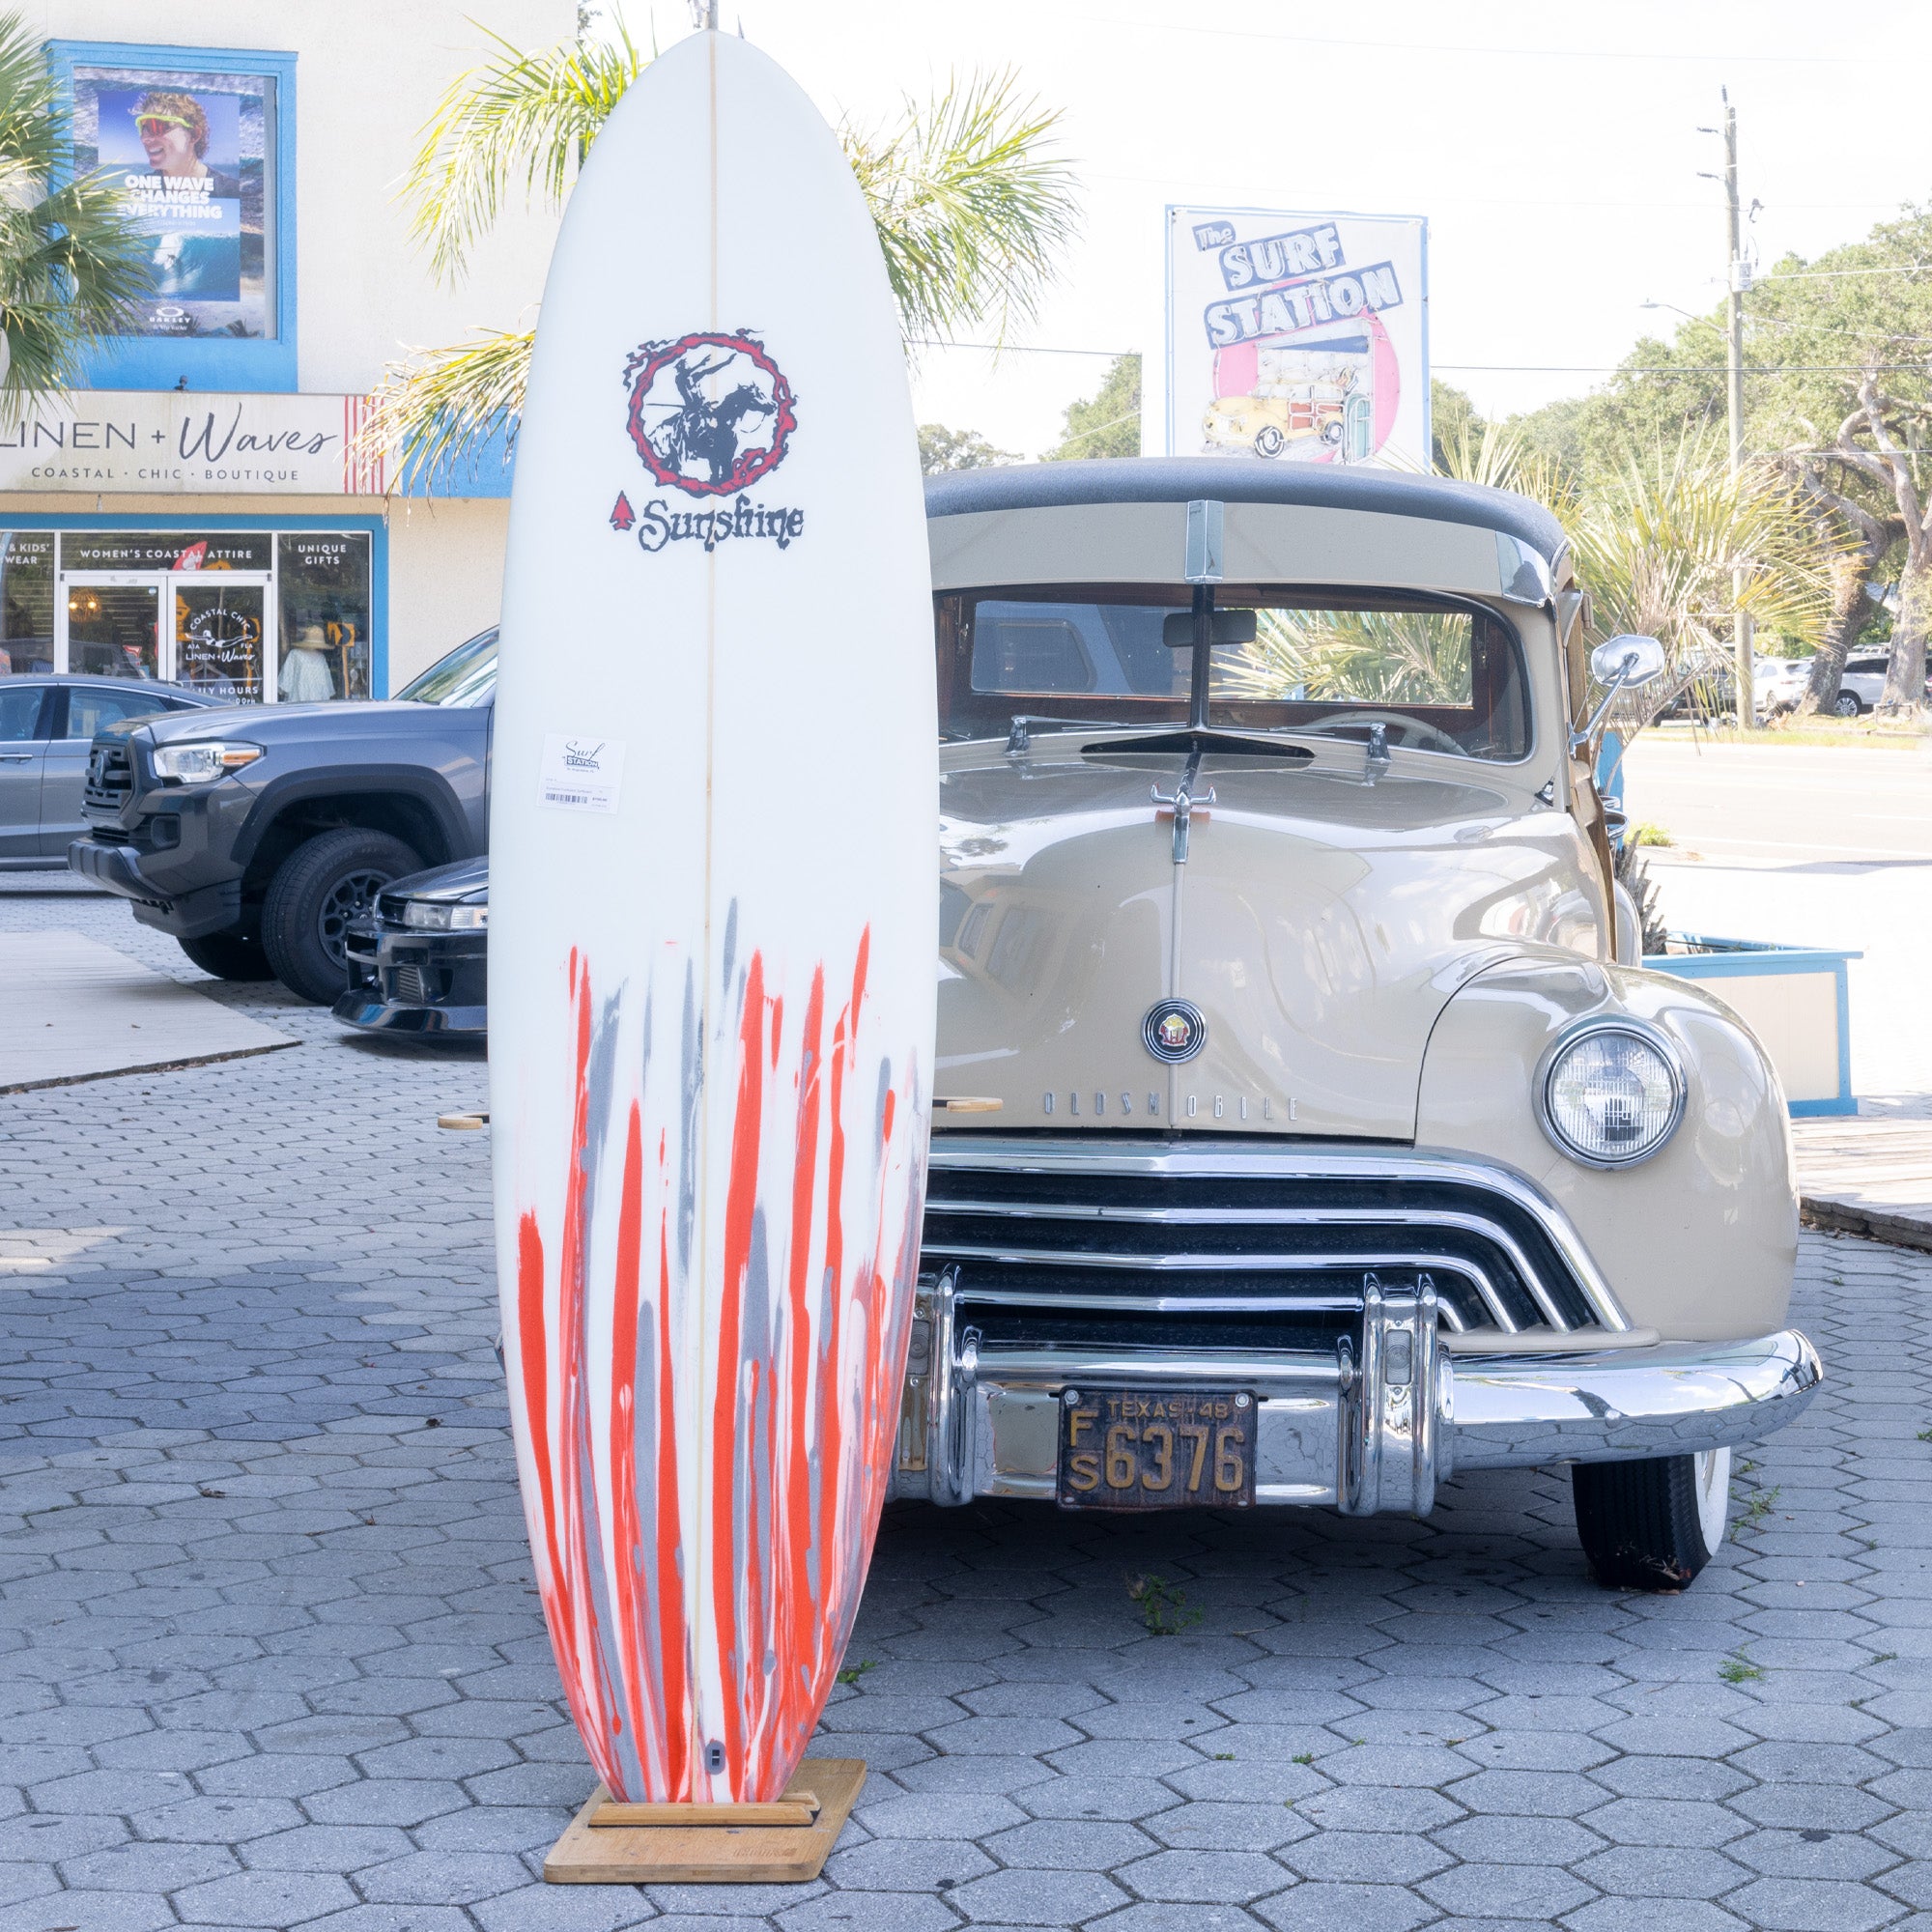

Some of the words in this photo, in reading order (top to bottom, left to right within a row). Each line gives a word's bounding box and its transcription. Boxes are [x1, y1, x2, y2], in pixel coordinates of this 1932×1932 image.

[124, 175, 162, 189] ONE
[163, 176, 214, 191] WAVE
[1195, 226, 1236, 245] The
[1222, 226, 1340, 288] SURF
[1207, 266, 1401, 346] STATION
[179, 402, 338, 462] Waves
[31, 467, 114, 479] COASTAL
[138, 469, 182, 480] CHIC
[205, 469, 298, 483] BOUTIQUE
[639, 493, 805, 552] Sunshine
[80, 549, 141, 558] WOMEN'S
[146, 550, 203, 559] COASTAL
[208, 550, 252, 558] ATTIRE
[298, 544, 347, 554] UNIQUE
[304, 555, 340, 565] GIFTS
[189, 609, 227, 630] COASTAL
[231, 611, 250, 630] CHIC
[221, 648, 255, 663] Waves
[219, 686, 258, 695] HOURS
[565, 740, 606, 760] Surf
[568, 756, 599, 768] STATION
[1044, 1091, 1298, 1121] OLDSMOBILE
[1106, 1425, 1244, 1492] 6376
